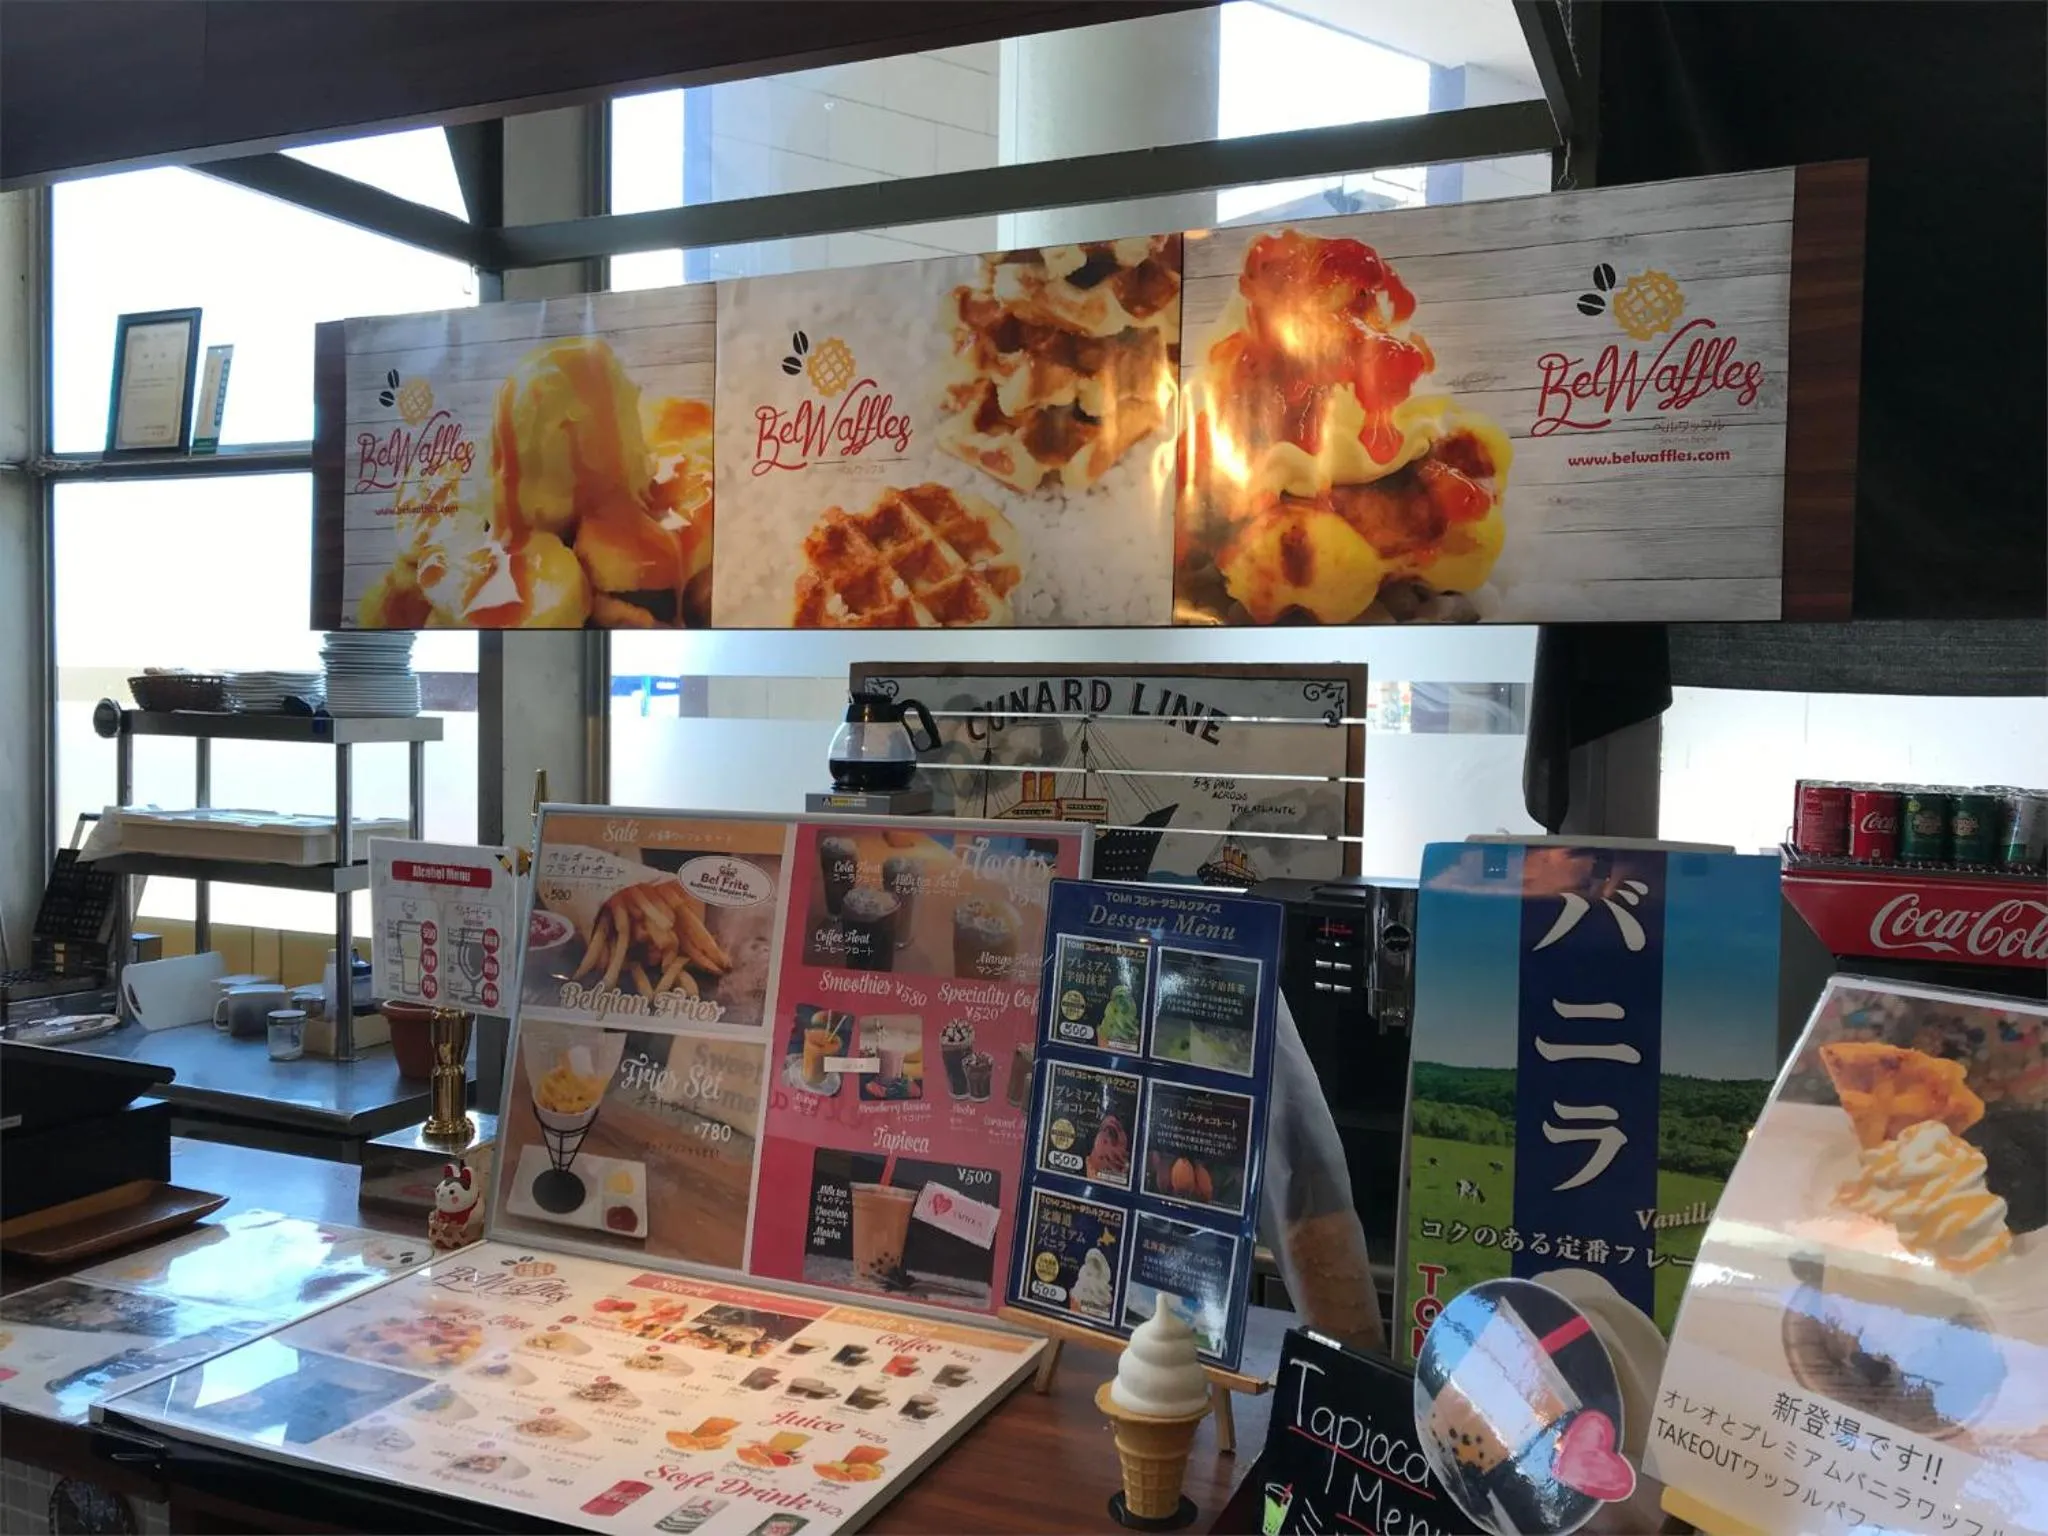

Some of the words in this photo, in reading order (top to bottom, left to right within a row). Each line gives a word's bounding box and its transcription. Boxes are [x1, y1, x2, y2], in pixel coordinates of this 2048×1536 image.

[1531, 318, 1764, 438] BelWaffles
[752, 378, 914, 477] BelWaffles
[355, 410, 476, 494] BelWaffles
[1568, 449, 1731, 467] www.belwaffles.com
[967, 679, 1112, 741] CUNARD
[1130, 682, 1228, 746] LINE
[412, 865, 444, 881] Alcohol
[445, 868, 471, 883] Menu
[701, 872, 720, 885] Bel
[815, 928, 844, 947] Coffee
[1089, 904, 1168, 933] Dessert
[1173, 913, 1238, 942] Menu
[560, 979, 649, 1018] Belgian
[652, 986, 726, 1023] Fries
[819, 971, 892, 996] Smoothies
[894, 981, 929, 1008] ¥580
[938, 982, 1012, 1014] Speciality
[964, 1005, 999, 1023] ¥520
[1532, 880, 1649, 1191] バニラ
[620, 1053, 678, 1093] Fries
[683, 1064, 724, 1100] Set
[872, 1125, 931, 1154] Tapioca
[957, 1167, 993, 1187] ¥500
[1038, 1236, 1067, 1253] バニラ
[1039, 1222, 1087, 1244] プレミアム
[1422, 1220, 1698, 1270] コクのある定番フレー
[874, 1332, 943, 1355] Coffee
[757, 1410, 846, 1434] Juice
[1289, 1358, 1430, 1494] Tapioca
[1772, 1390, 1944, 1486] 新登場です!!
[644, 1464, 716, 1492] Soft
[1663, 1388, 2008, 1536] オレオとプレミアムバニラワッフ
[1348, 1472, 1440, 1536] Men
